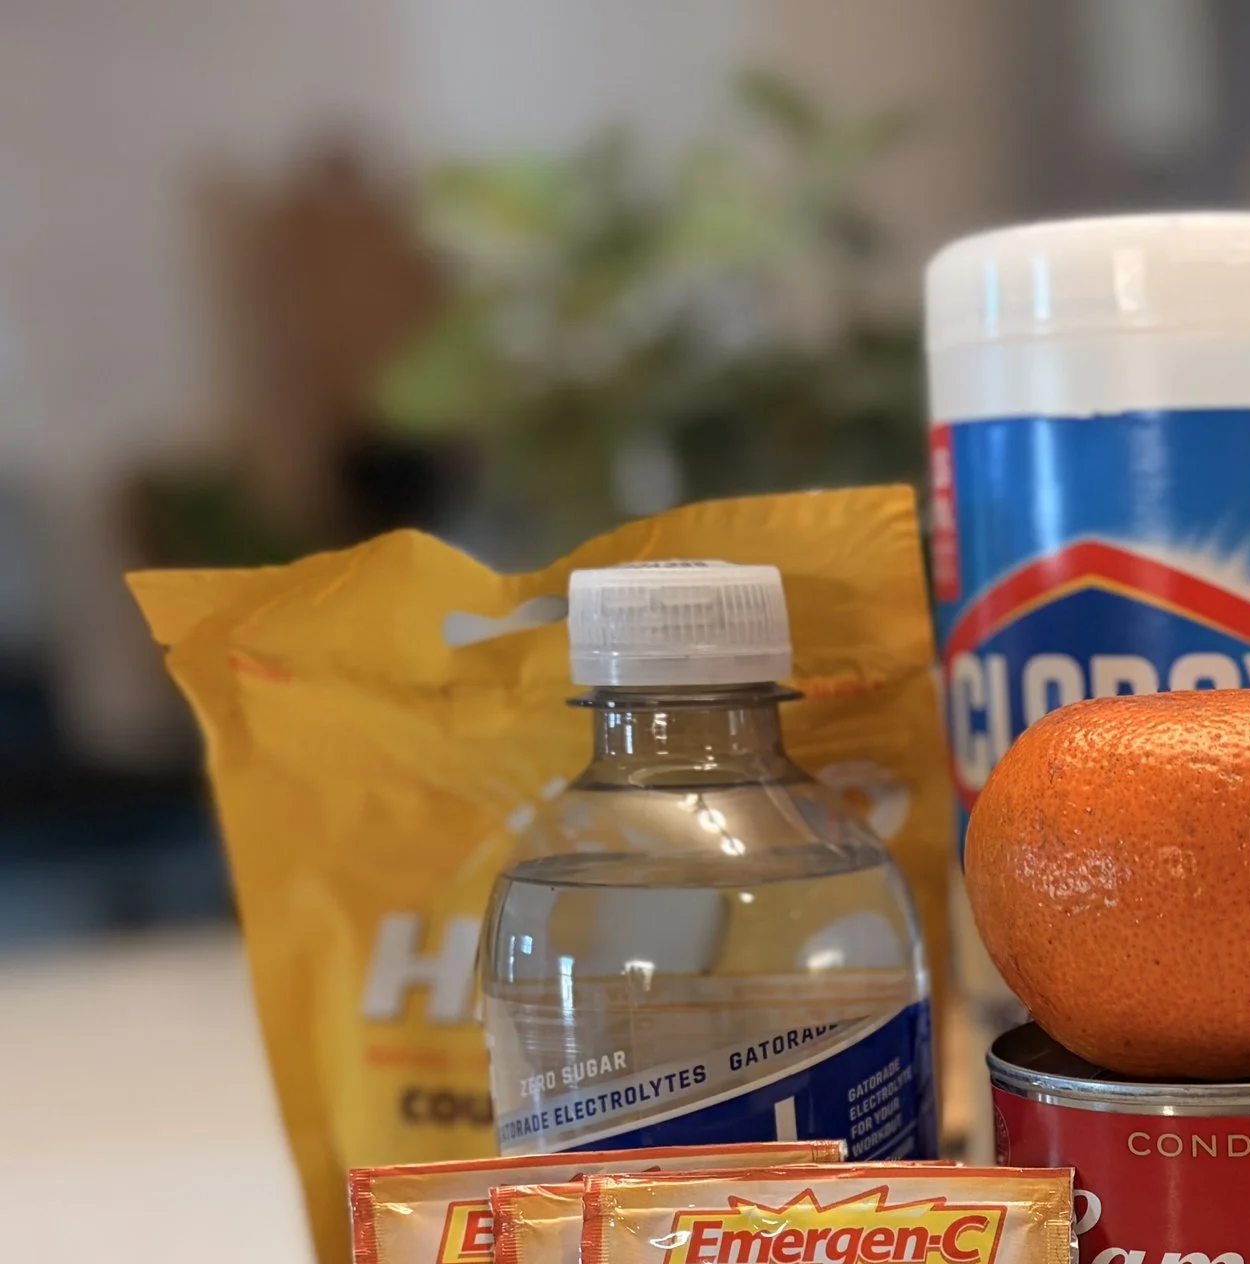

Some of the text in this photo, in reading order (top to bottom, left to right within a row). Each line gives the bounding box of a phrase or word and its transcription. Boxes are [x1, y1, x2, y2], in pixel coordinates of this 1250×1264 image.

[520, 1050, 627, 1098] ZERO SUGAR
[555, 1064, 707, 1126] ELECTROLYTES
[849, 1057, 900, 1102] GATORADE
[851, 1097, 900, 1139] FOR YOUR
[852, 1114, 902, 1157] WORKOUT
